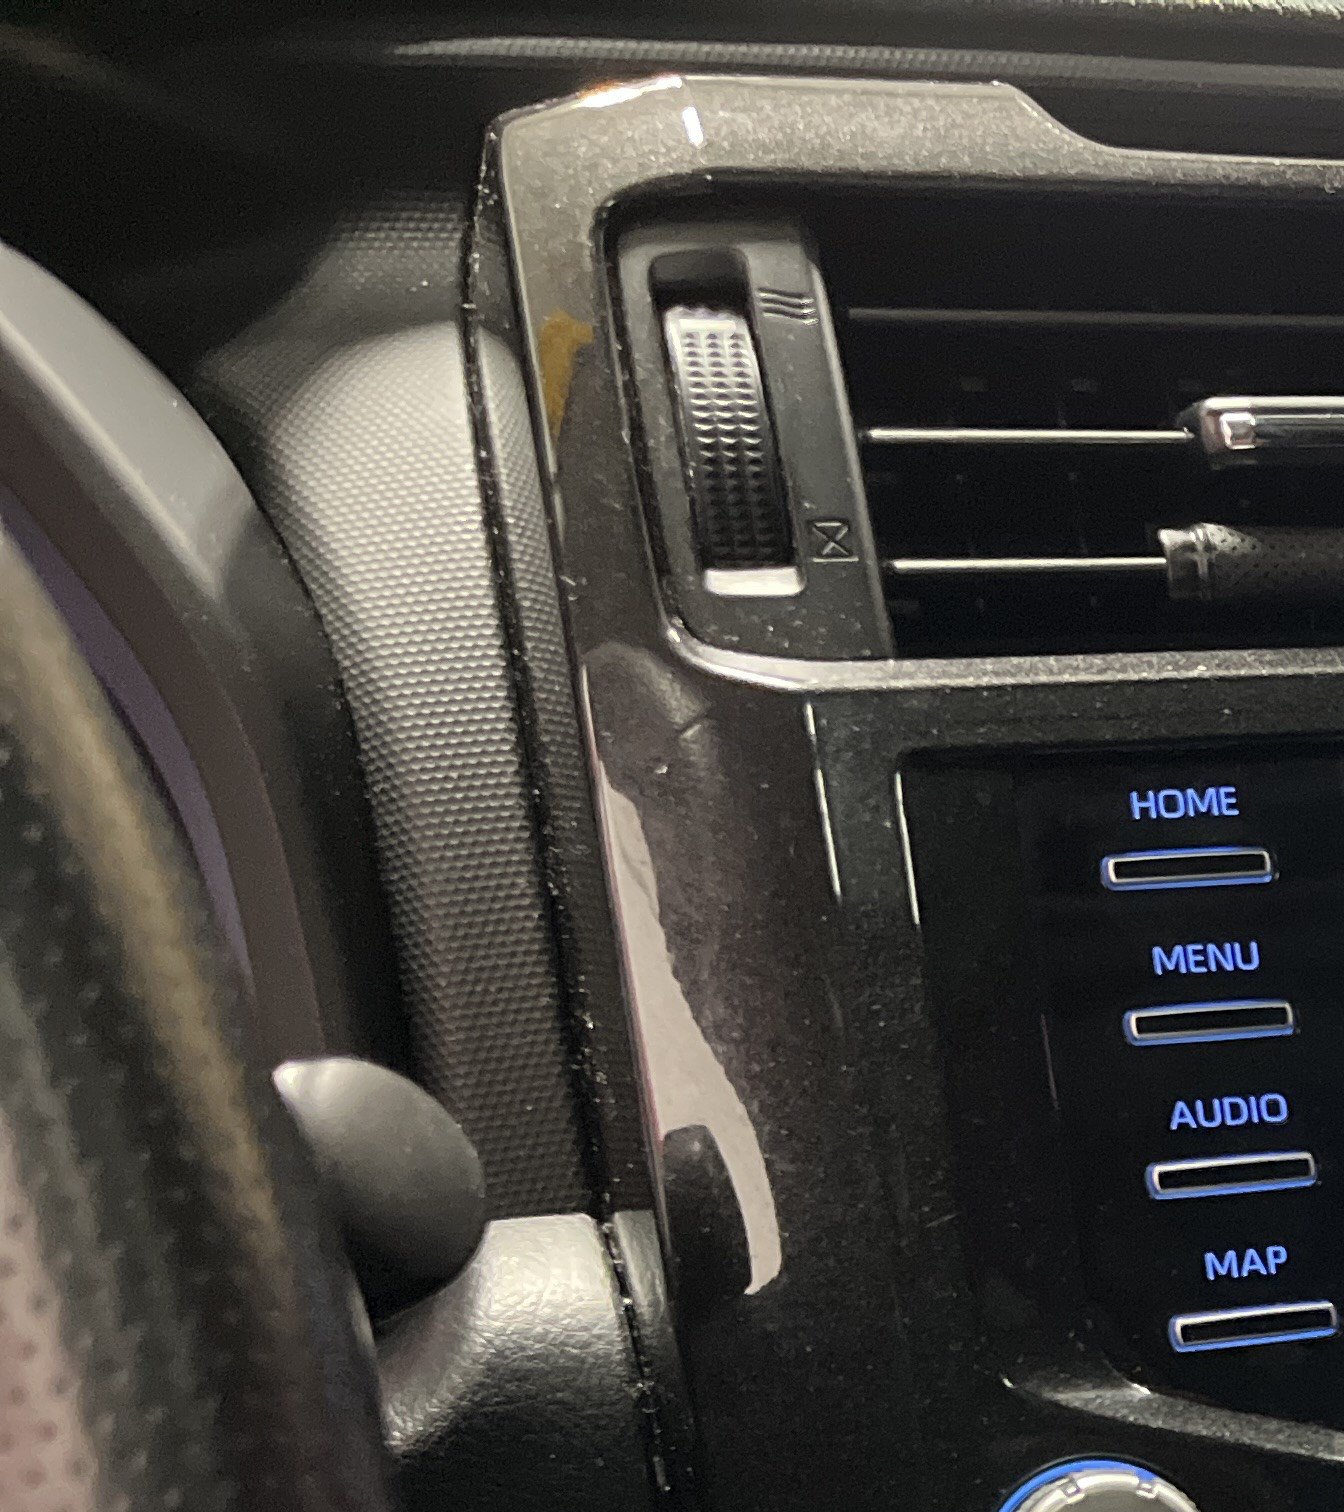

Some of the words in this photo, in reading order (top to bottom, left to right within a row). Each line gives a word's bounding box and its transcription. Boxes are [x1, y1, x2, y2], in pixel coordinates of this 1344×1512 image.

[1130, 785, 1240, 821] HOME
[1151, 941, 1260, 975] MENU
[1169, 1092, 1288, 1131] AUDIO
[1203, 1245, 1288, 1281] MAP
